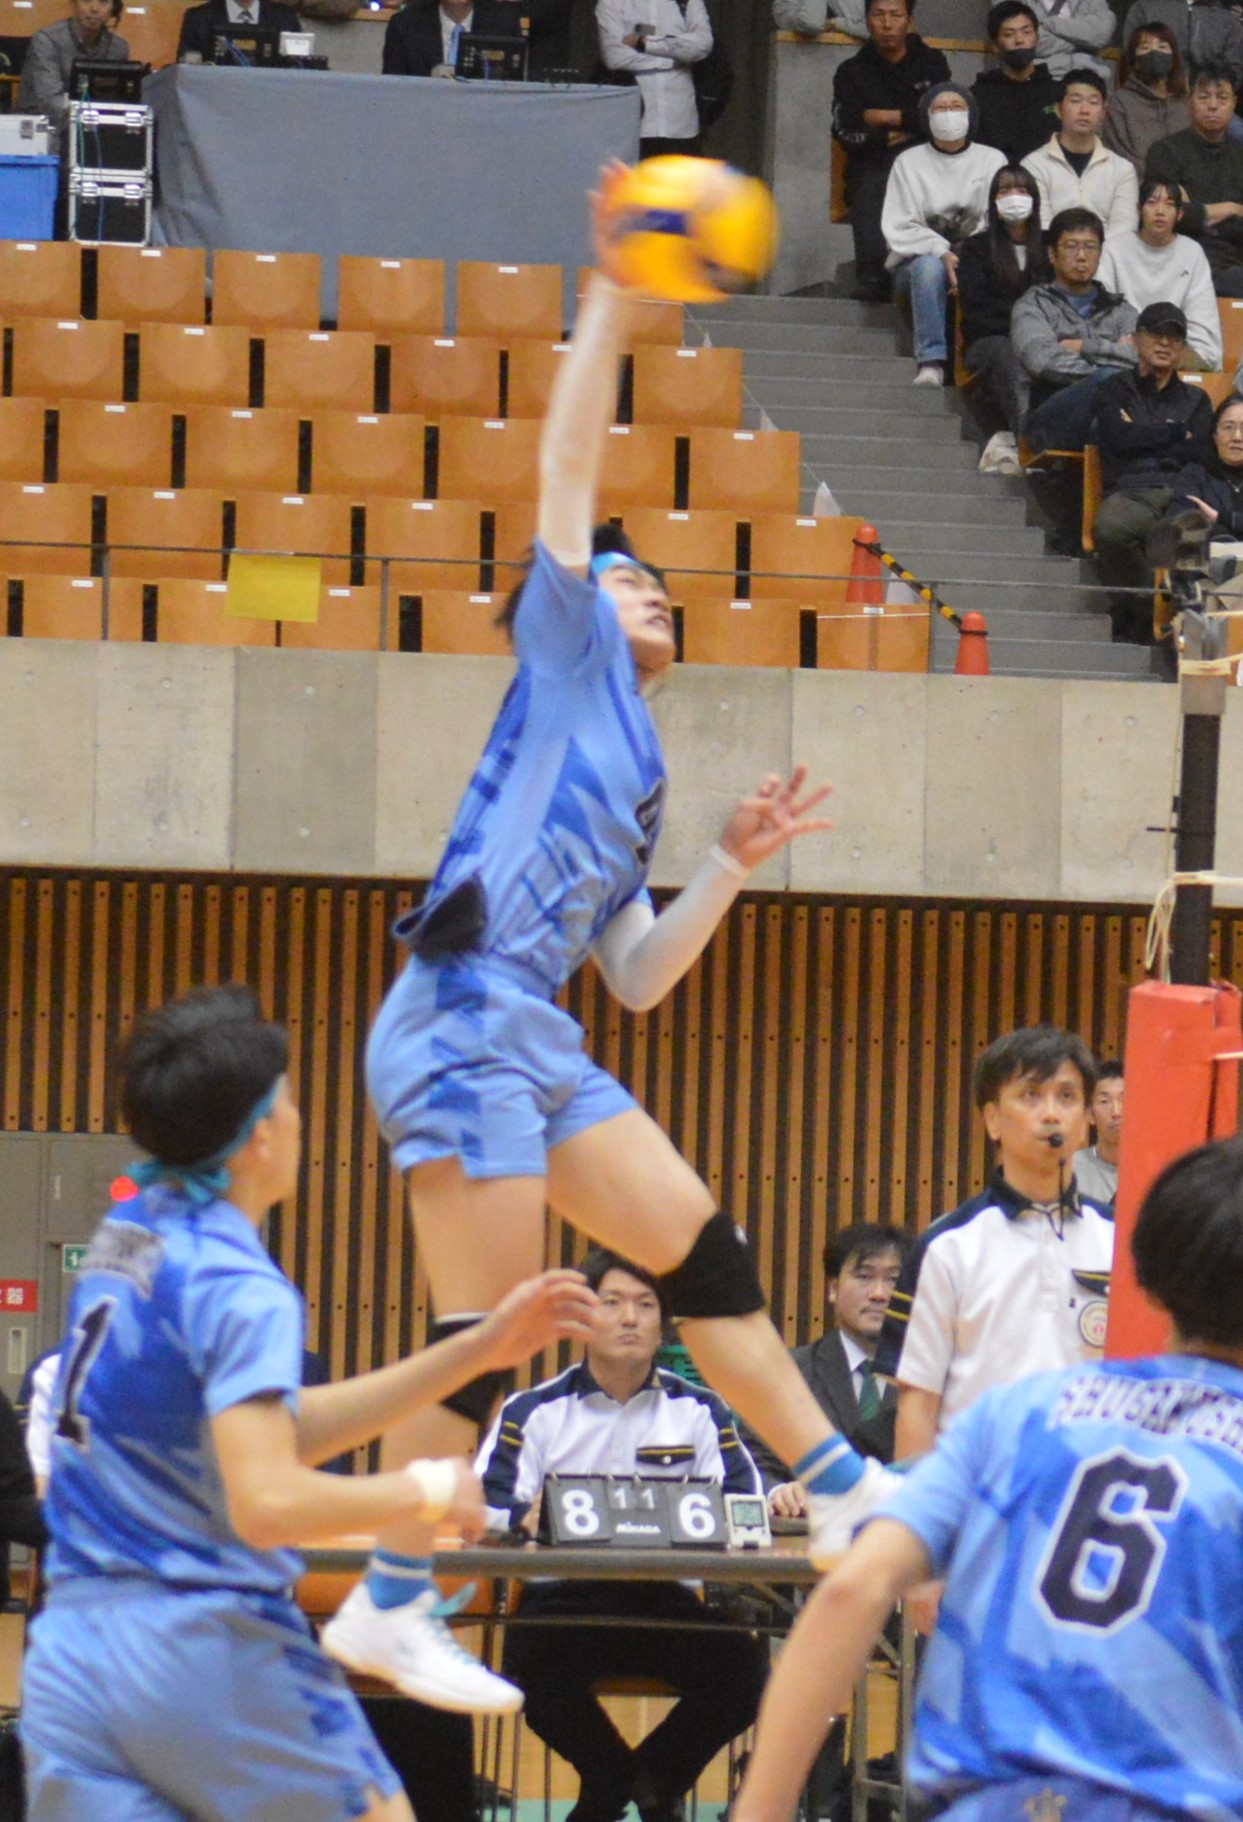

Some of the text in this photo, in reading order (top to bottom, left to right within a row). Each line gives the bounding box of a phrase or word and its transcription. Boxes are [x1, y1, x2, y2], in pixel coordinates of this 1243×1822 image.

[562, 1489, 600, 1535] 8
[679, 1492, 715, 1538] 6
[1032, 1446, 1189, 1637] 6
